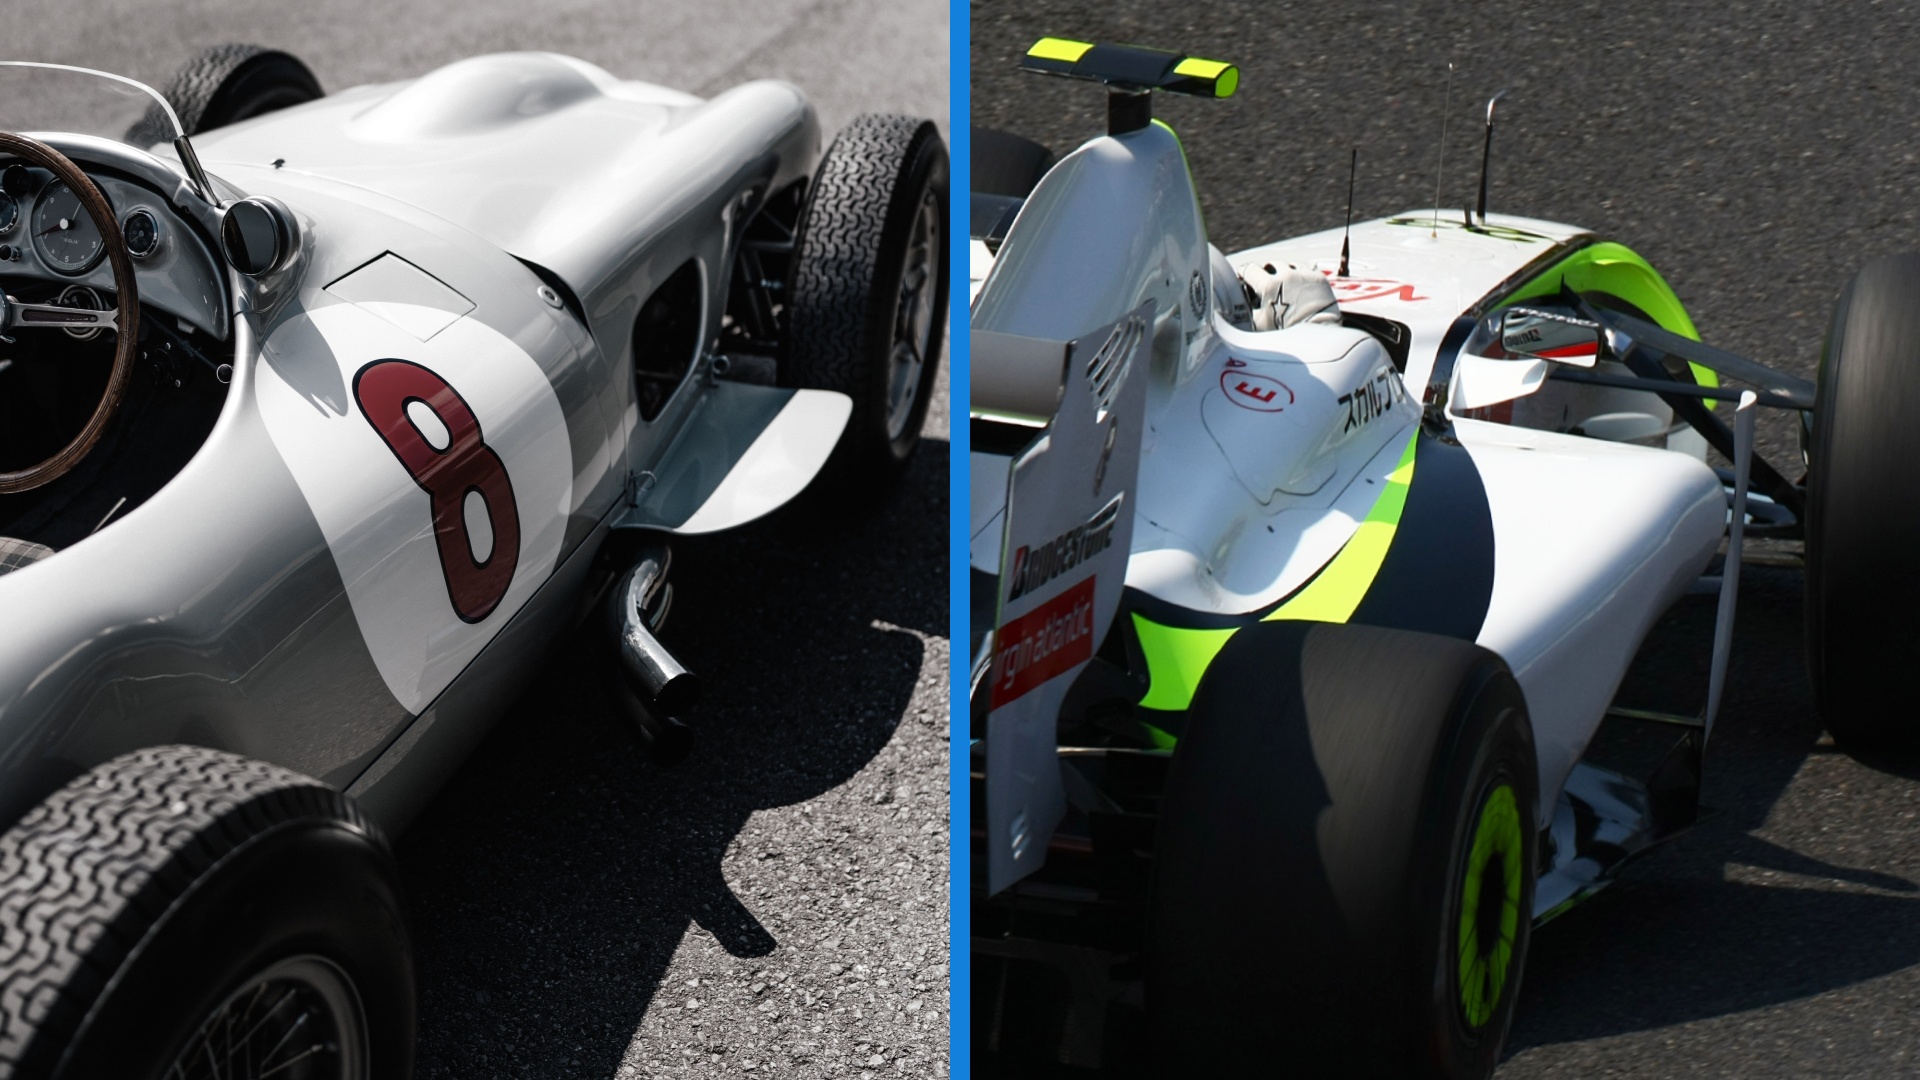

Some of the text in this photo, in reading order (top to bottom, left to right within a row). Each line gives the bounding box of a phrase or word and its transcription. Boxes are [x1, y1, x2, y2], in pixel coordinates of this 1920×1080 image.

[91, 241, 96, 249] 3
[64, 255, 70, 263] 5
[1234, 381, 1277, 403] E
[352, 357, 521, 624] 8
[1032, 595, 1091, 663] atlantic
